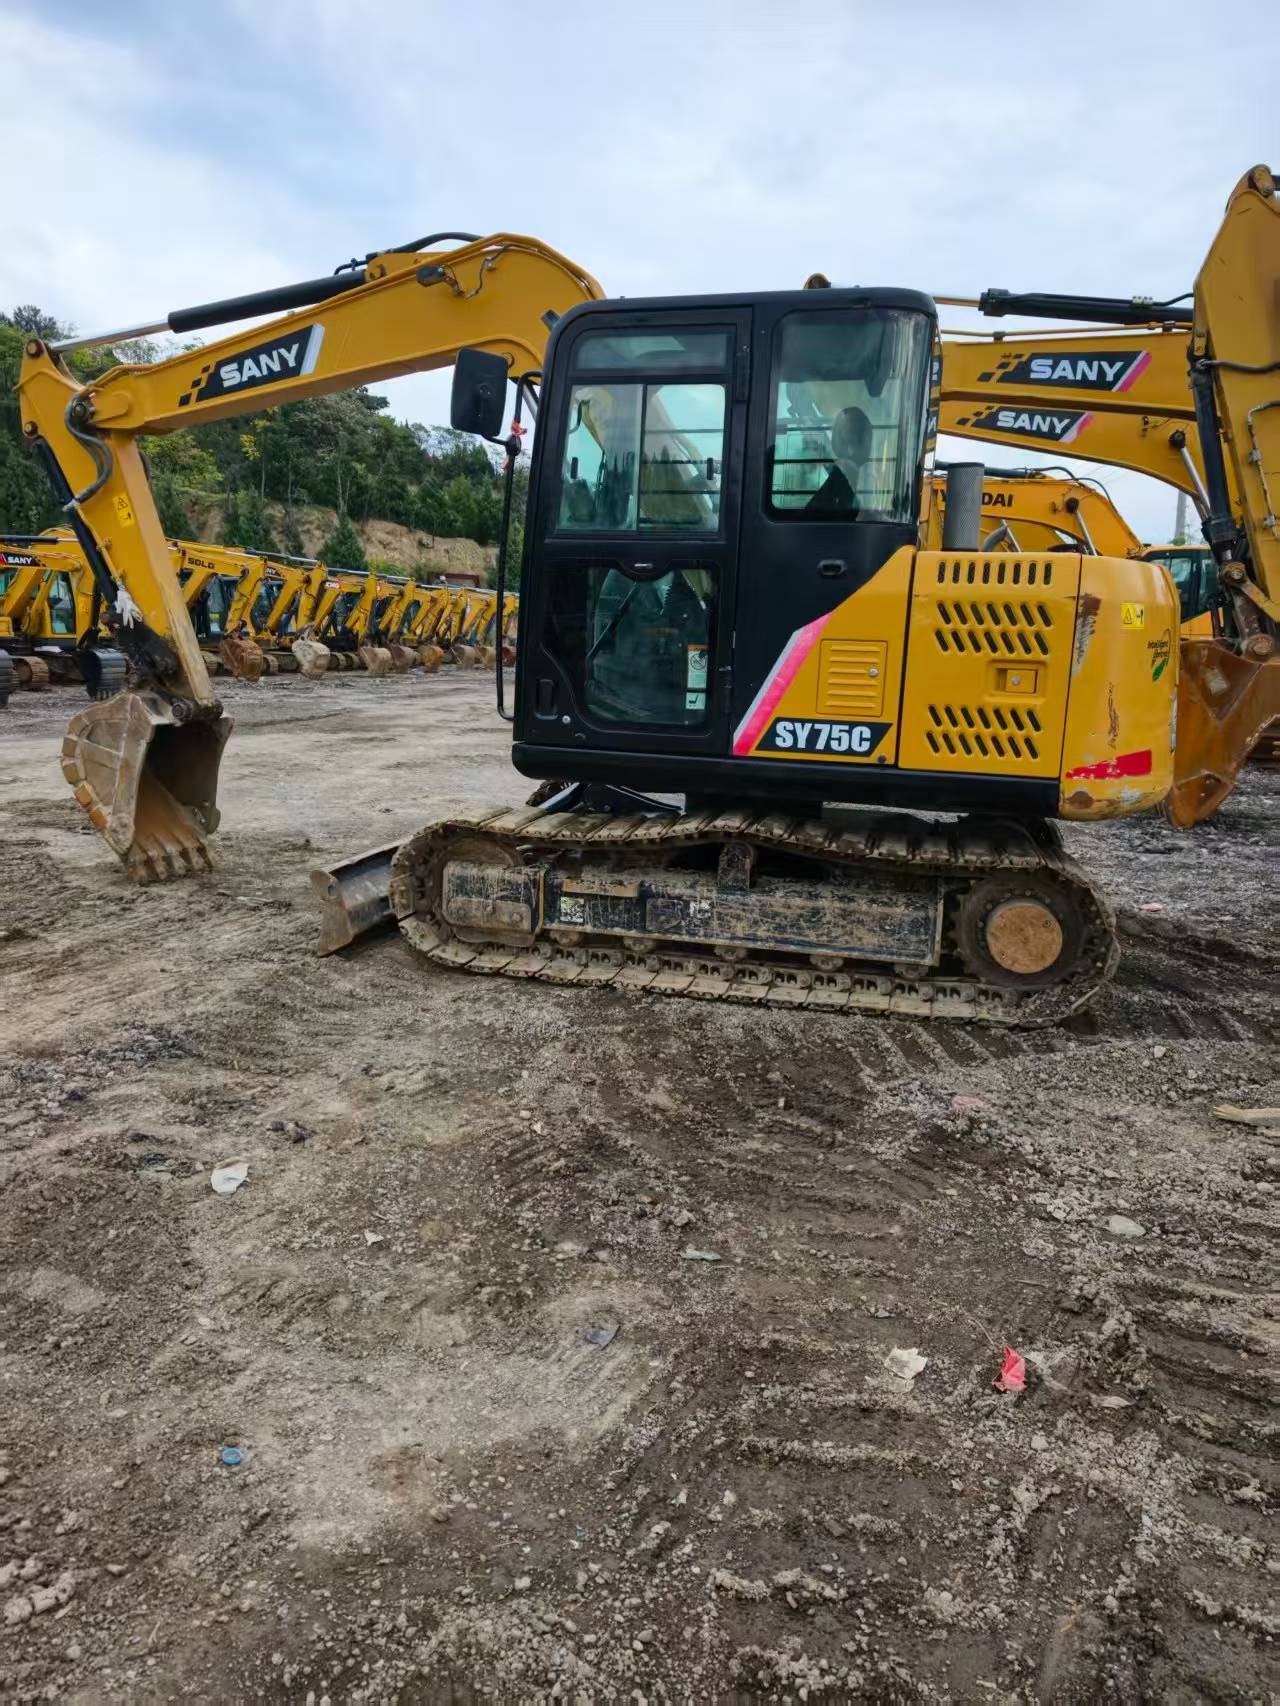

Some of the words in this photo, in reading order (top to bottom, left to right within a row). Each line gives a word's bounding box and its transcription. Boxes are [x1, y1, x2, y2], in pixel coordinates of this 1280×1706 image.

[219, 343, 300, 388] SANY
[1030, 358, 1124, 382] SANY
[997, 410, 1071, 434] SANY
[7, 556, 33, 565] SANY
[775, 721, 872, 752] SY75C
